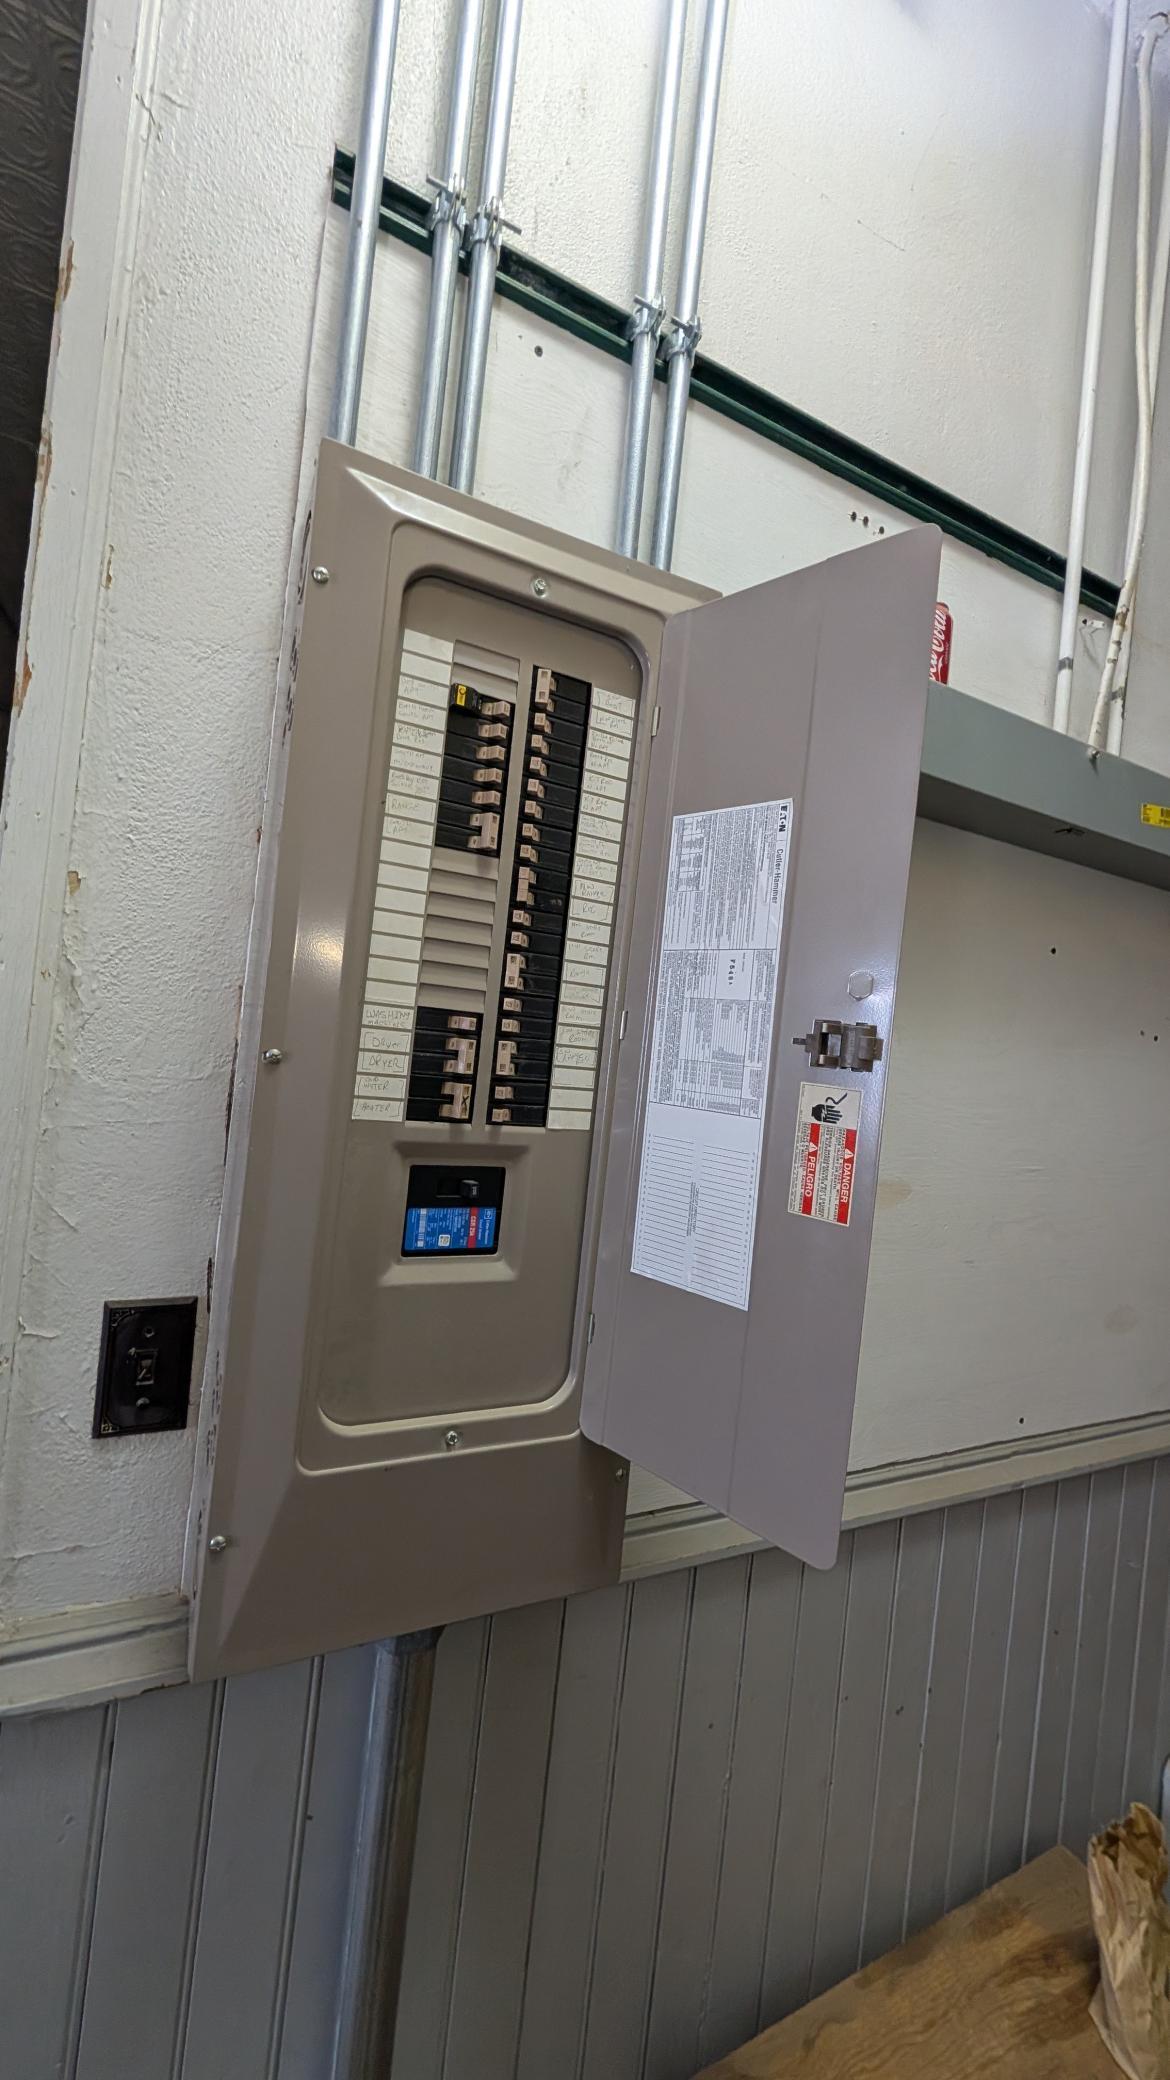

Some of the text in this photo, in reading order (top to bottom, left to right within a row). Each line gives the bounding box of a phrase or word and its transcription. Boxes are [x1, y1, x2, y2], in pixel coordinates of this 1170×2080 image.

[772, 848, 784, 904] Cutler-Hammer
[804, 1156, 817, 1197] PELIGRO
[840, 1163, 854, 1203] DANGER
